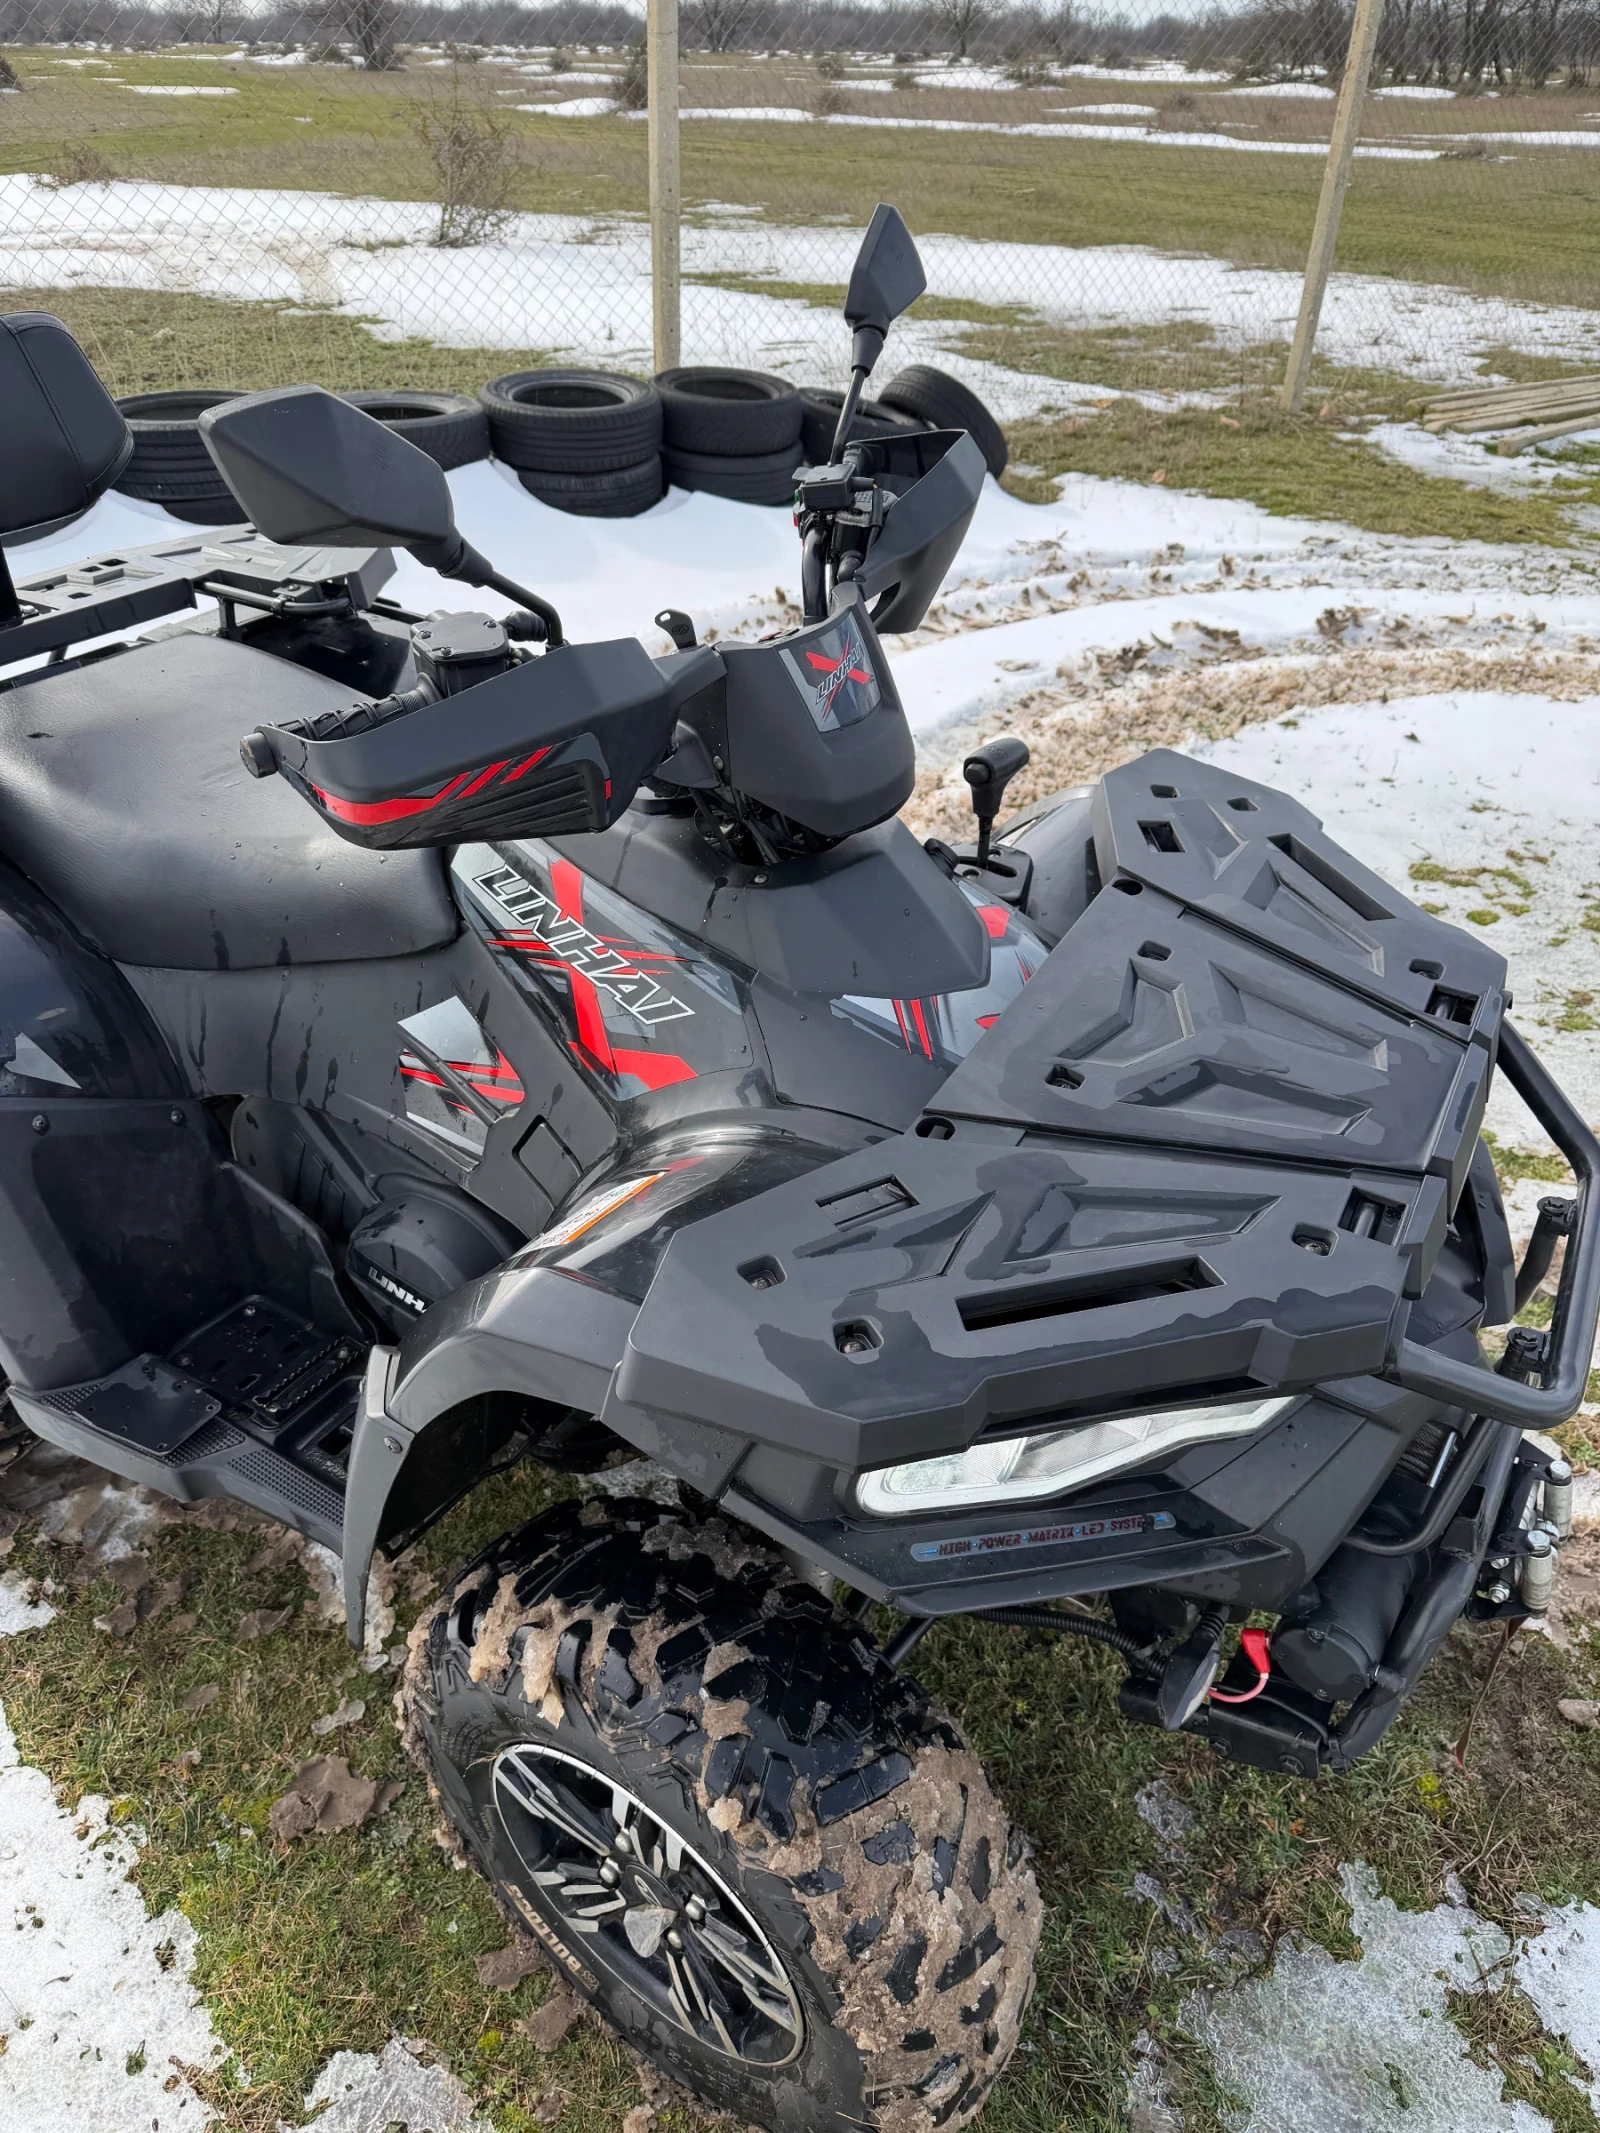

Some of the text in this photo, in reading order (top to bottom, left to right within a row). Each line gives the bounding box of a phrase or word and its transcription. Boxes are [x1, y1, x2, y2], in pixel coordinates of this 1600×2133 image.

[815, 642, 863, 705] LINHAI
[472, 864, 696, 1025] LINHAI
[368, 1266, 428, 1314] LINH
[938, 1516, 1144, 1556] HIGH POWER MATRIX LED SYSTE
